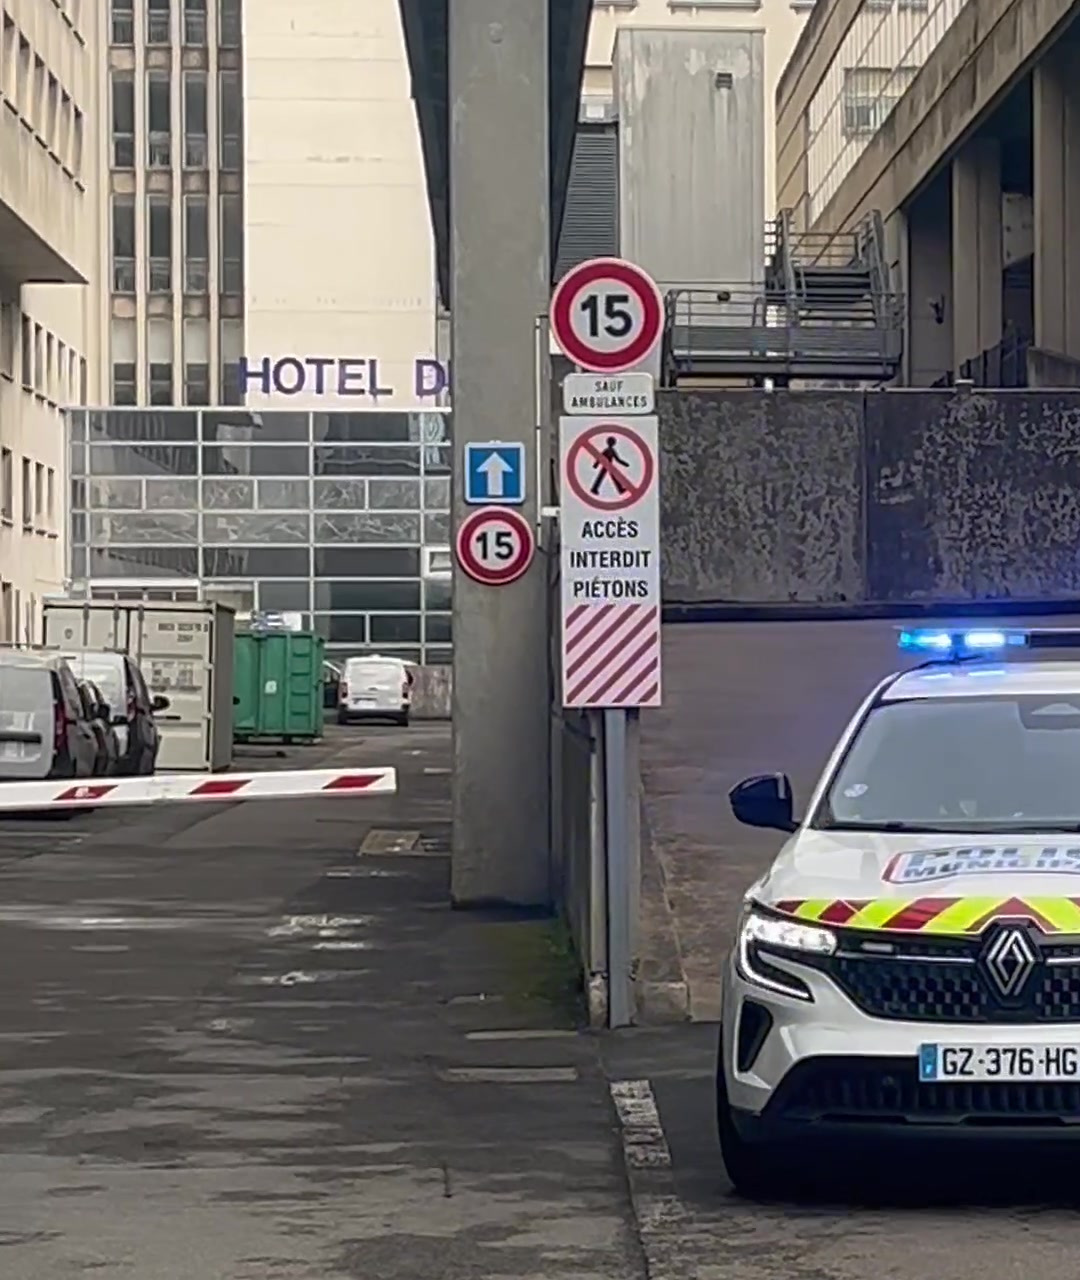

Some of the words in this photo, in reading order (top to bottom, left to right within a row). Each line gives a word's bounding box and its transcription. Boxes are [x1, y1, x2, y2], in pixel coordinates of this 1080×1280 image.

[581, 294, 633, 338] 15
[239, 357, 393, 396] HOTEL
[416, 359, 452, 397] D
[594, 381, 623, 392] SAUF
[571, 396, 648, 408] AMBULANCES
[581, 515, 639, 539] ACCÈS
[475, 531, 514, 560] 15
[570, 550, 651, 568] INTERDIT
[573, 576, 649, 598] PIÉTONS
[942, 1047, 1078, 1076] GZ-376-HG
